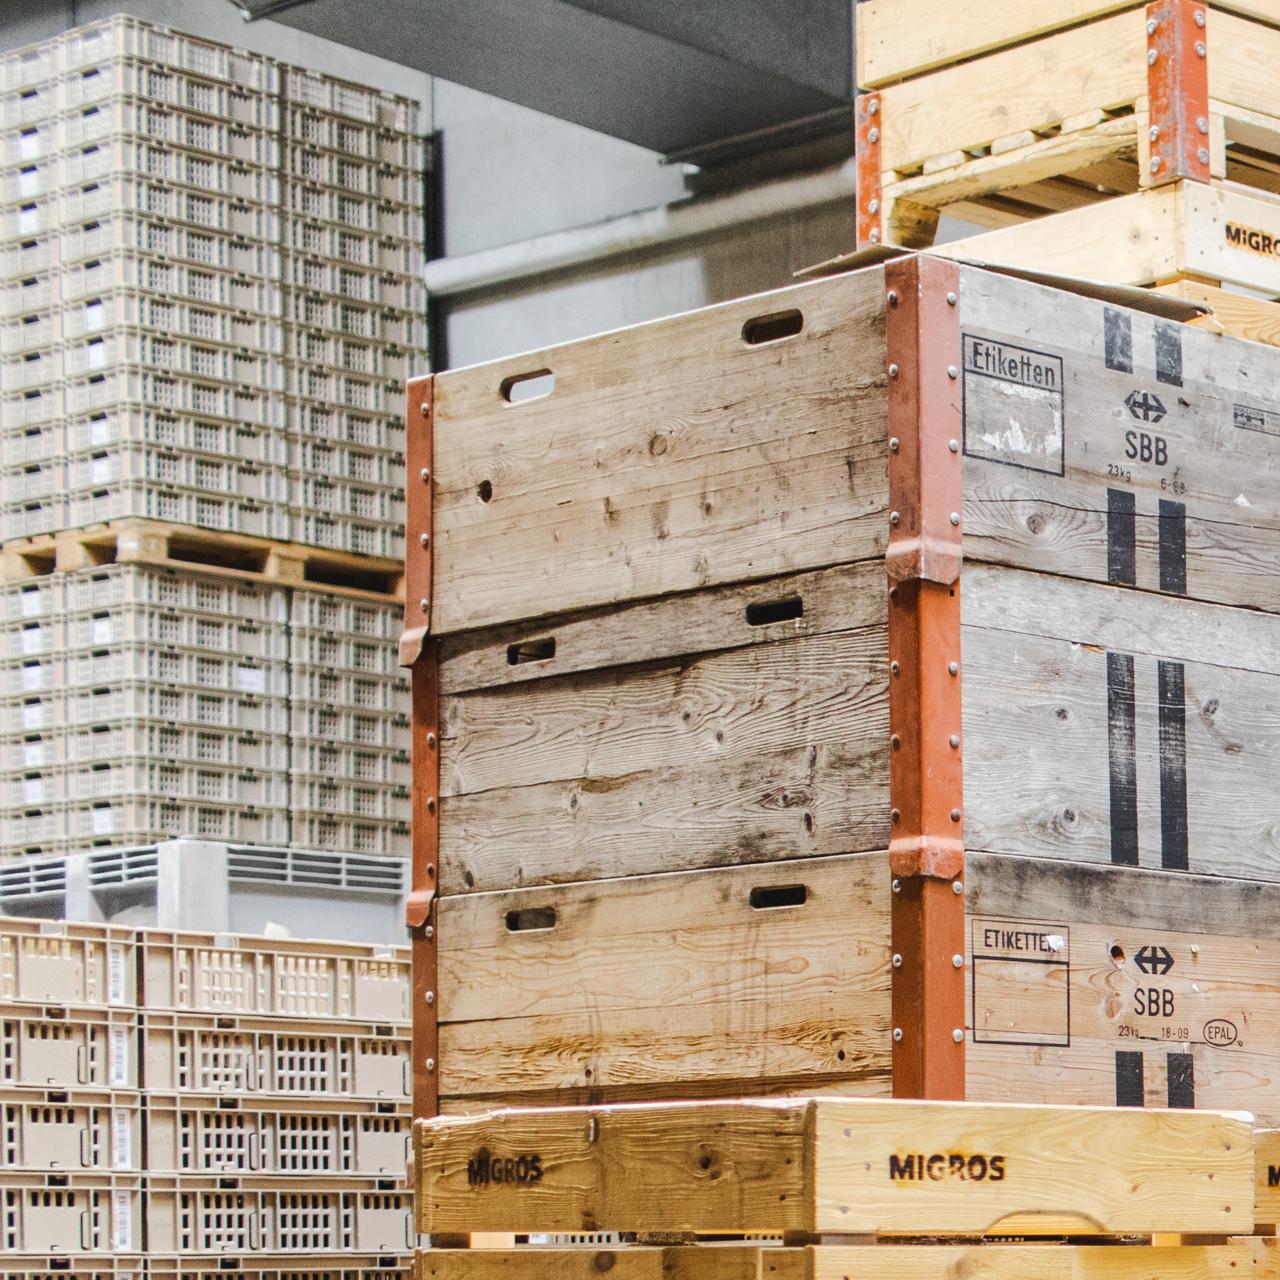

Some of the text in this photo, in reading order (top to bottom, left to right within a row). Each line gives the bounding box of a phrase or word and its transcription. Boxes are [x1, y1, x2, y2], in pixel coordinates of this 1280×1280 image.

[972, 341, 1055, 387] Etiketten
[1125, 430, 1168, 466] SBB
[1134, 988, 1174, 1017] SBB
[1161, 1026, 1189, 1039] 18-09
[1208, 1025, 1233, 1040] EPAL
[467, 1154, 544, 1186] MIGROS
[889, 1154, 1006, 1181] MIGROS
